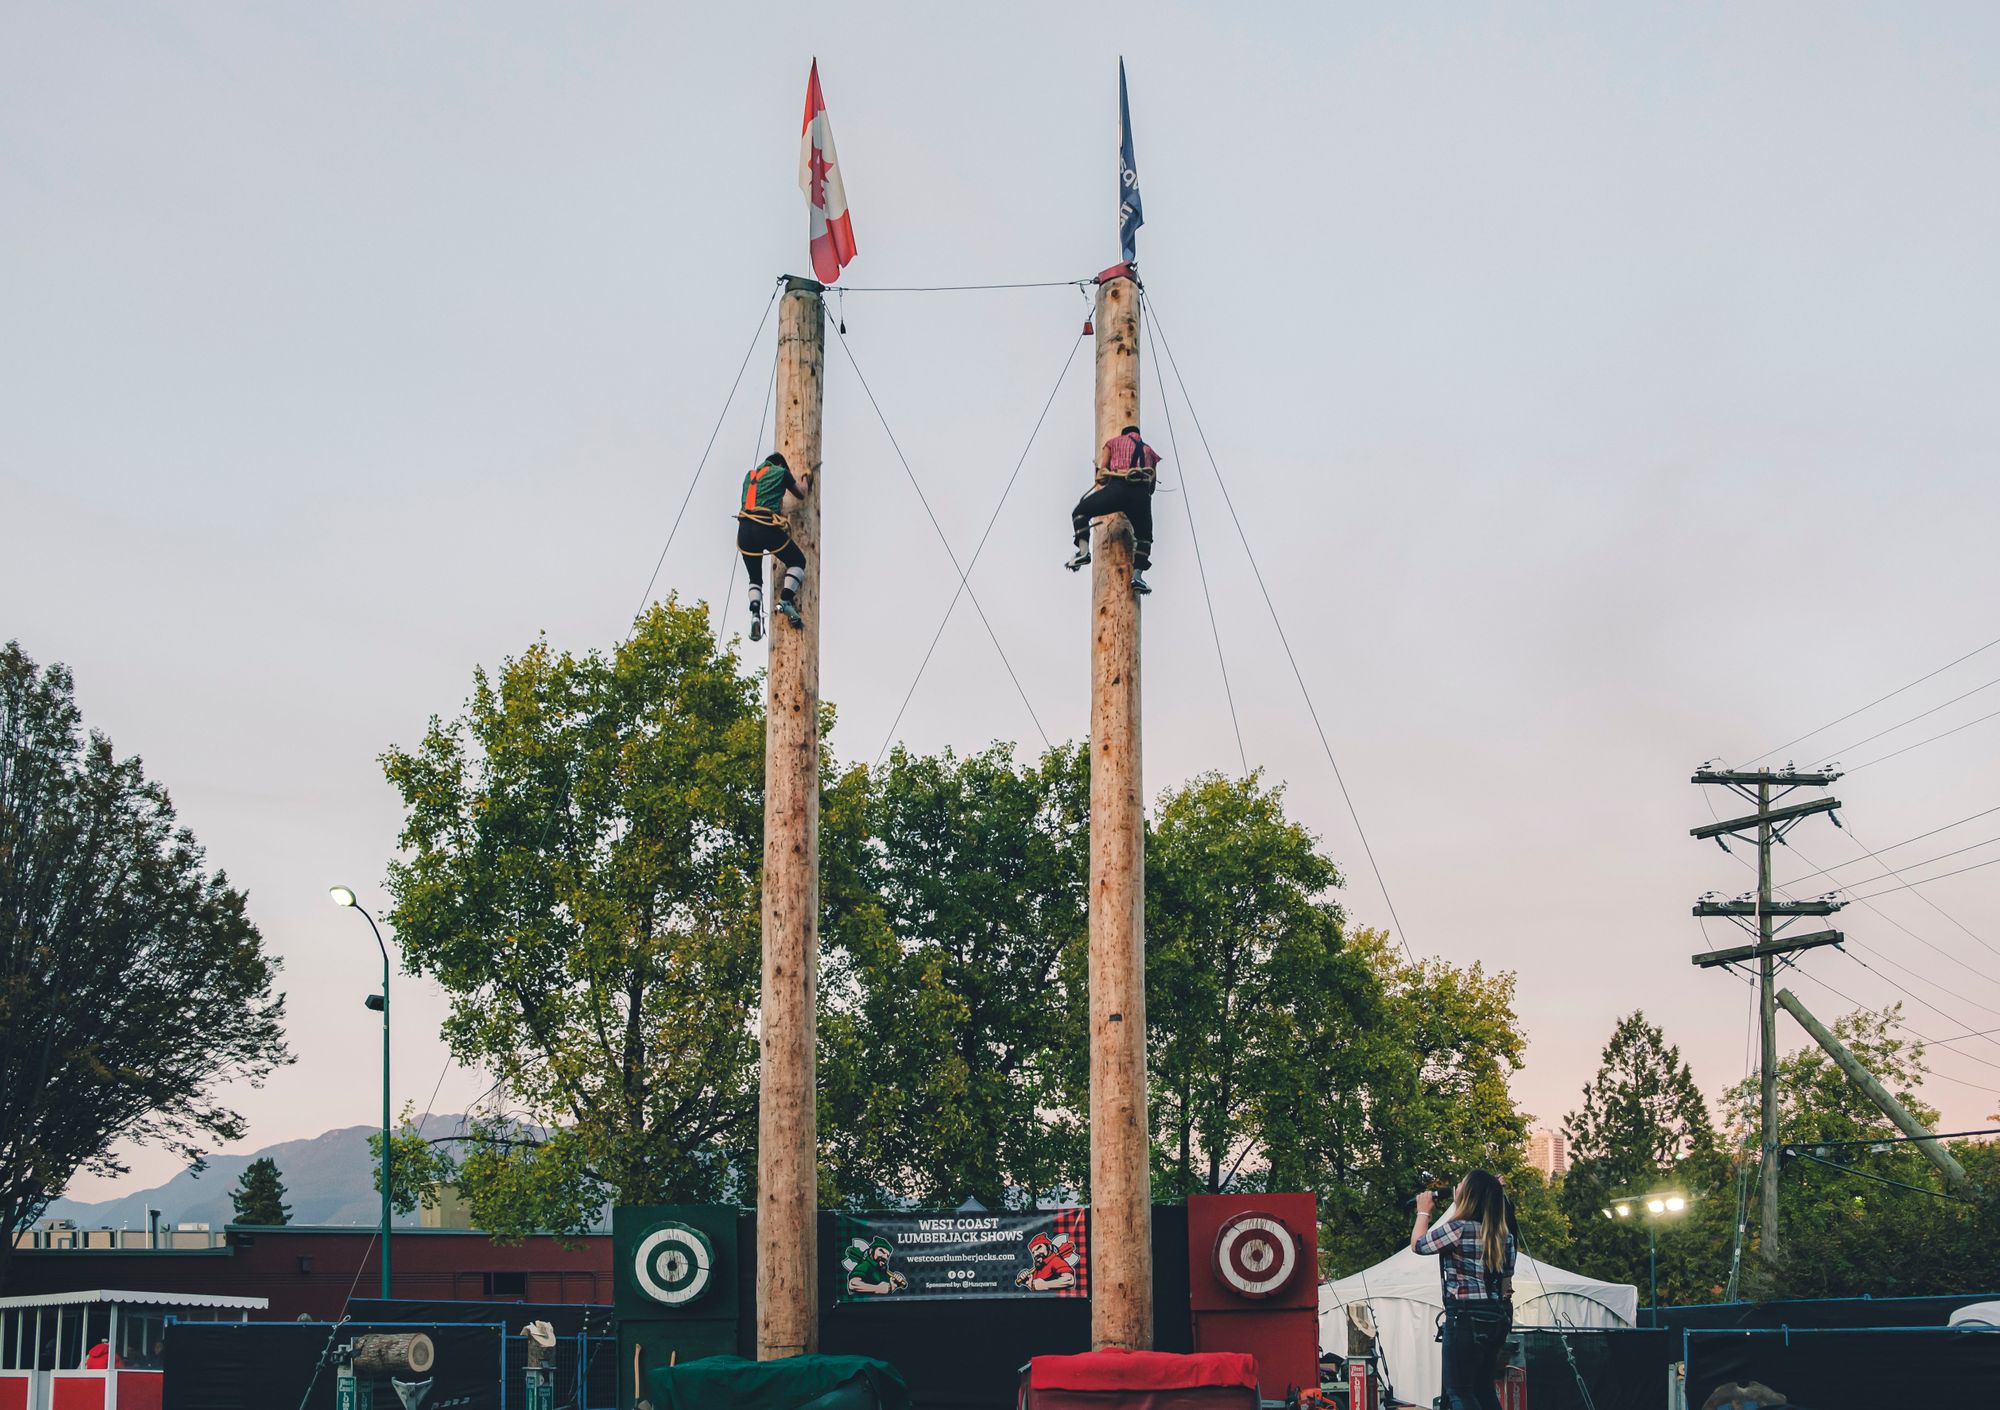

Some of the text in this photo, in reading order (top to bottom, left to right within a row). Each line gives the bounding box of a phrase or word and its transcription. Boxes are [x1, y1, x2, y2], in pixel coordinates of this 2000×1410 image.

[918, 1217, 999, 1231] WEST COAST
[897, 1230, 1024, 1244] LUMBERJACK SHOWS
[906, 1253, 1015, 1263] westcoastlumberjacks.com
[925, 1281, 953, 1289] Sponsored
